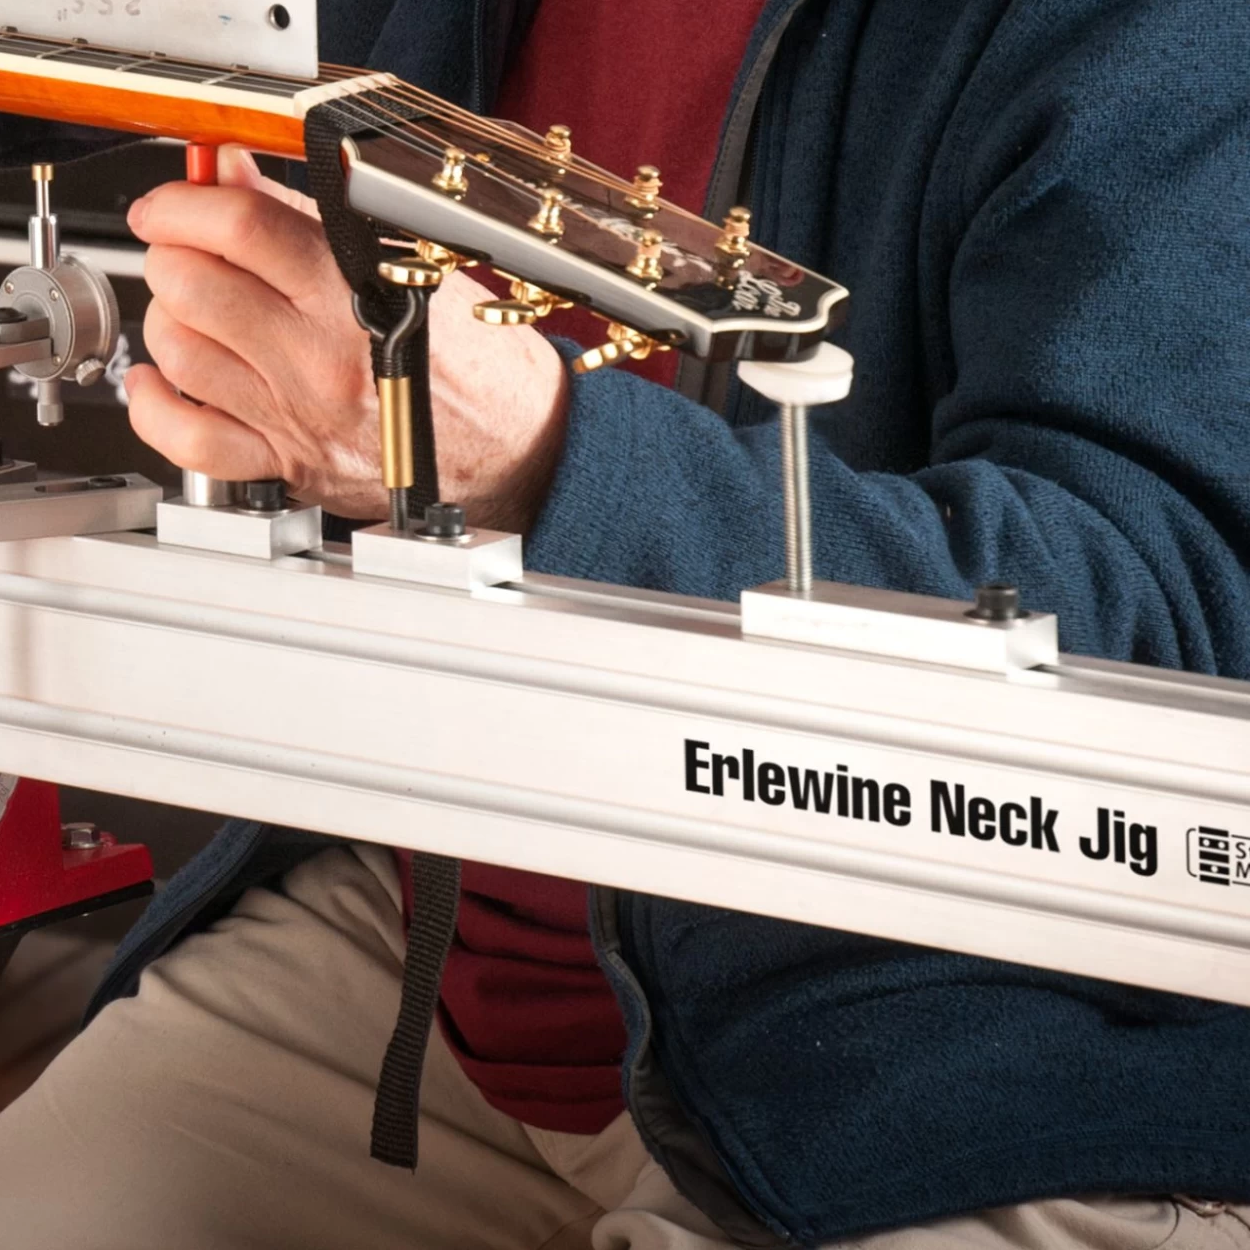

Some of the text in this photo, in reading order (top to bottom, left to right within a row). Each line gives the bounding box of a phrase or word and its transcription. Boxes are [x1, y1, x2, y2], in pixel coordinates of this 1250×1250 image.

[684, 738, 1158, 877] Erlewine Neck Jig
